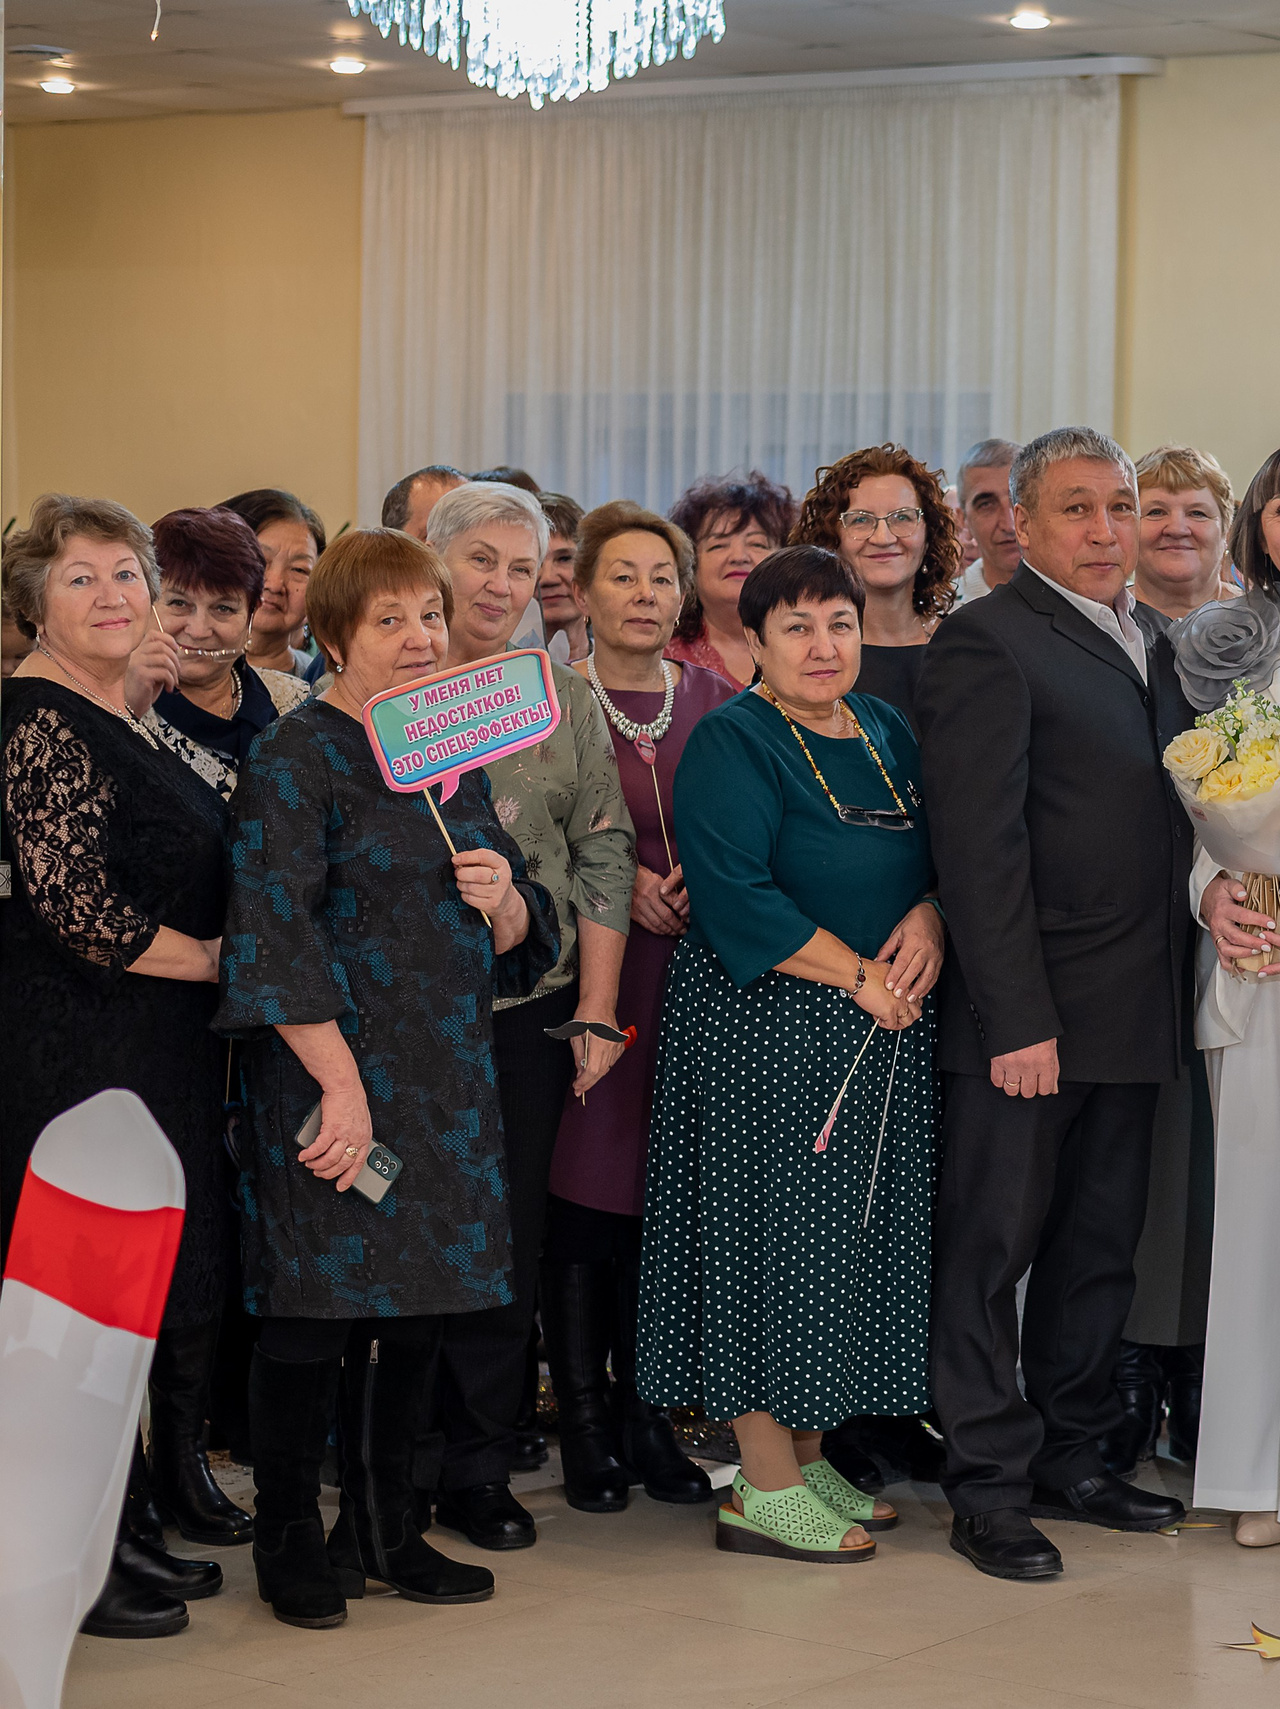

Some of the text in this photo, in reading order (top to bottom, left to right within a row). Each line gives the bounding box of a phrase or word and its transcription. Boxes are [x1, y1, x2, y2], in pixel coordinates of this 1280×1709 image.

[404, 684, 522, 742] НЕДОСТАТКОВ!
[408, 666, 504, 712] У МЕНЯ НЕТ
[392, 701, 550, 776] ЭТО СПЕЦЭФФЕКТЫ!
